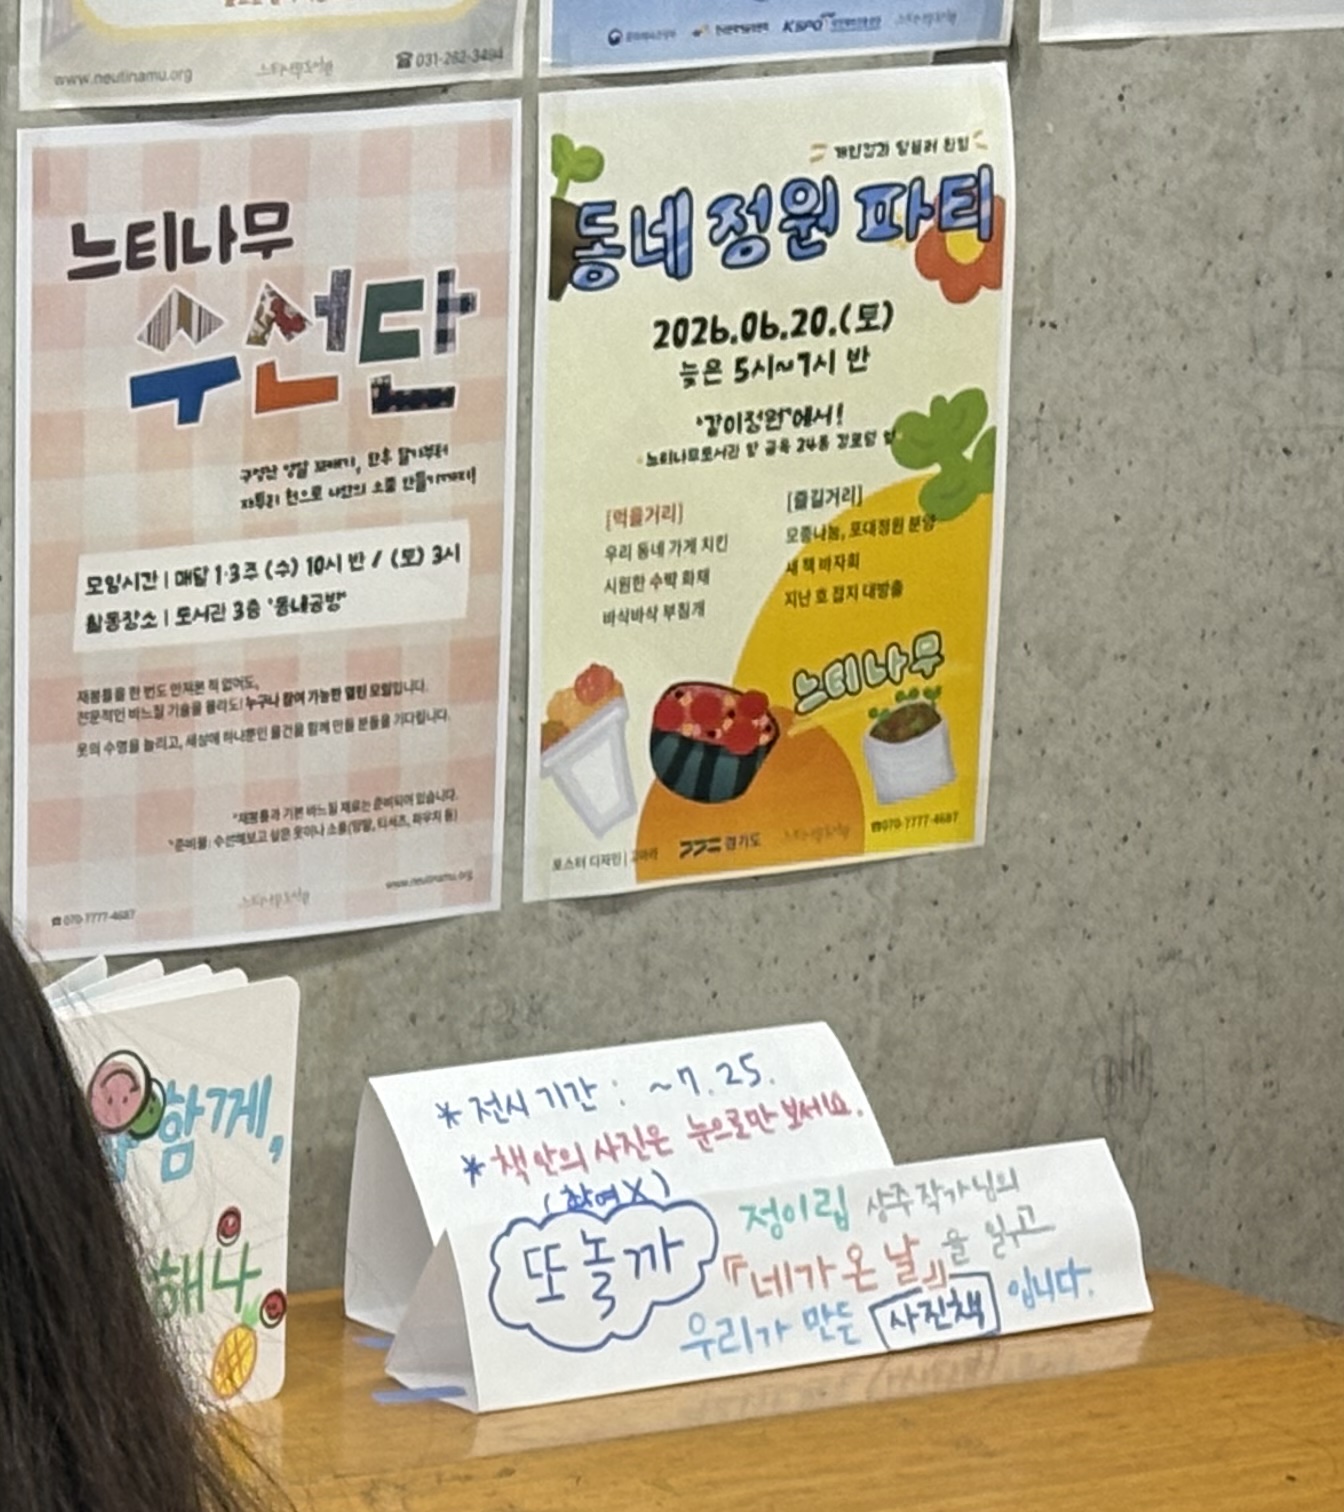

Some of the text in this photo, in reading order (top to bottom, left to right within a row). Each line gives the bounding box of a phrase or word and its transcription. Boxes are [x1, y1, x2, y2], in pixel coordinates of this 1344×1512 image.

[66, 200, 295, 282] 느티나무
[568, 163, 996, 292] 동네 정원 파티
[128, 266, 480, 429] 수선단
[678, 344, 872, 391] 늦은 5시~7시 반
[174, 564, 209, 589] 매달
[264, 555, 300, 582] (수)
[305, 552, 343, 578] 10시
[347, 549, 366, 575] 반
[389, 545, 426, 571] (토)
[430, 542, 462, 567] 3시
[701, 533, 729, 554] 치킨
[174, 601, 227, 628] 도서관
[792, 629, 946, 717] 느티나무
[468, 1076, 599, 1126] 전시 기간
[594, 1123, 674, 1165] 사진은
[686, 1107, 779, 1155] 눈으로만
[841, 1203, 1057, 1293] 온 읽고
[679, 1256, 1096, 1360] 우리가 만든 사진책 입니다.
